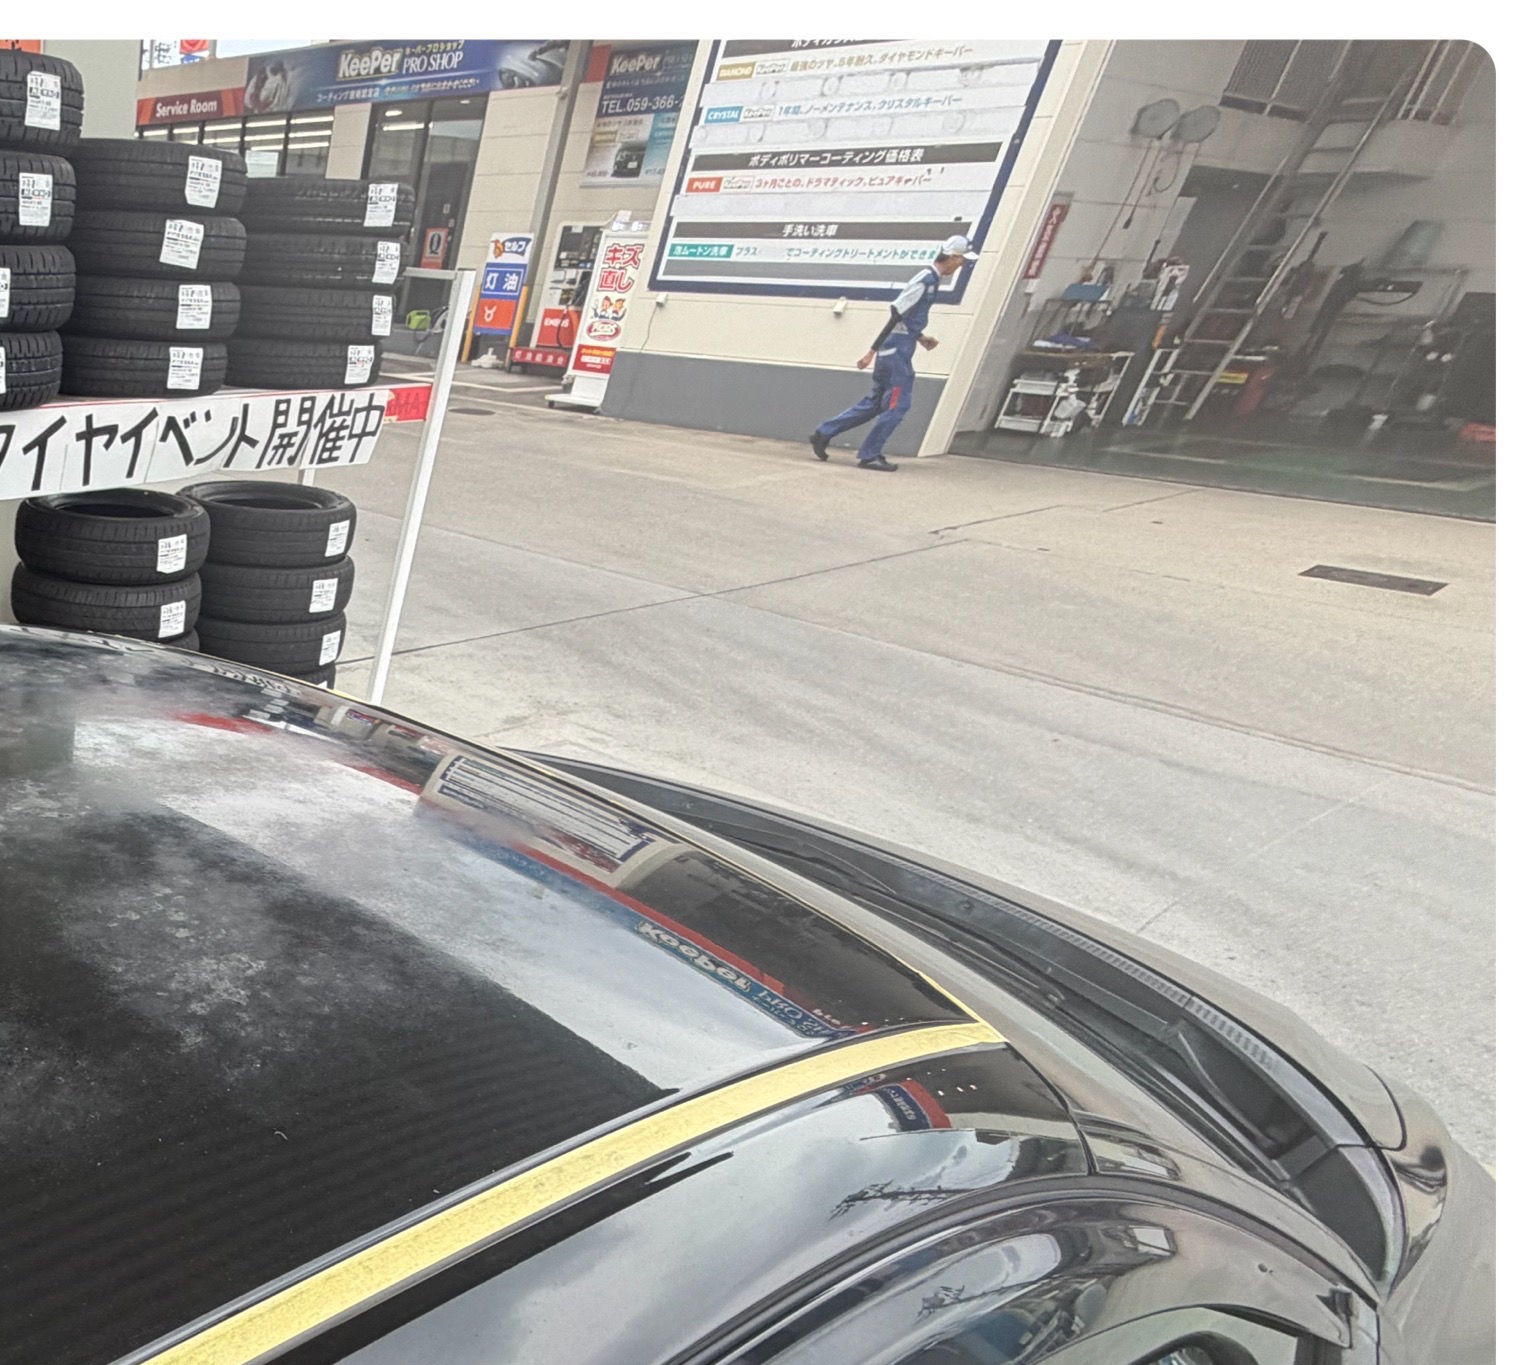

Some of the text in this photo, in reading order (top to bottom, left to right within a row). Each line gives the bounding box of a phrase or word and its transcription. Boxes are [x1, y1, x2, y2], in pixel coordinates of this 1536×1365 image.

[339, 50, 464, 78] KeePer PRO SHOP
[609, 54, 661, 75] KeePer
[156, 99, 217, 118] Service Room
[707, 110, 740, 120] CRYSTAL
[748, 148, 925, 167] ボディポリマーコーティング価格表
[692, 180, 717, 190] PURE
[782, 223, 839, 238] 手洗い洗車
[603, 243, 645, 270] キズ
[484, 272, 520, 291] 灯油
[597, 269, 636, 294] 直し
